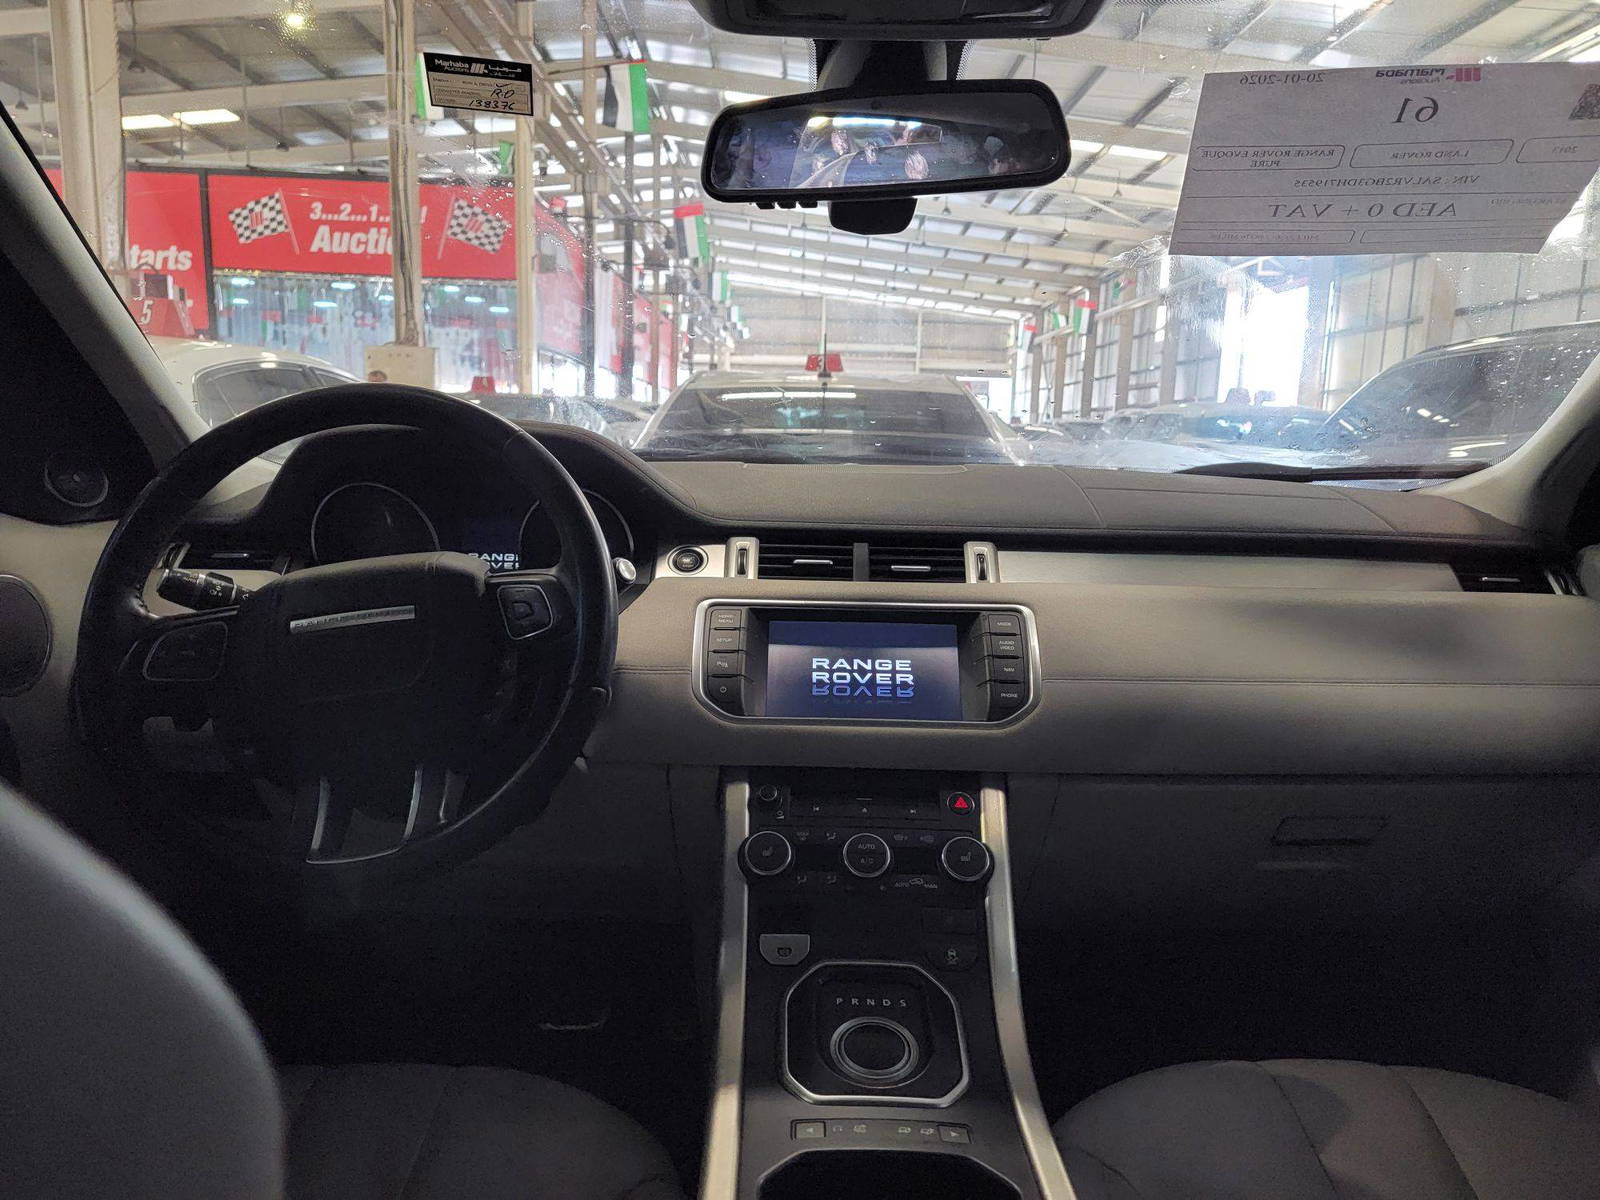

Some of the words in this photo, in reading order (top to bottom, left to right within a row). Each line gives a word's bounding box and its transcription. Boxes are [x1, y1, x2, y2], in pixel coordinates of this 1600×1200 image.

[434, 59, 469, 68] Marhaba
[309, 224, 393, 255] Aucti
[129, 244, 193, 271] tarts
[139, 299, 153, 326] 5
[467, 552, 519, 562] RANG
[811, 657, 912, 671] RANGE
[811, 671, 915, 685] ROVER
[836, 997, 843, 1005] P
[851, 998, 859, 1006] R
[866, 998, 875, 1006] N
[882, 999, 891, 1007] D
[899, 999, 907, 1008] S
